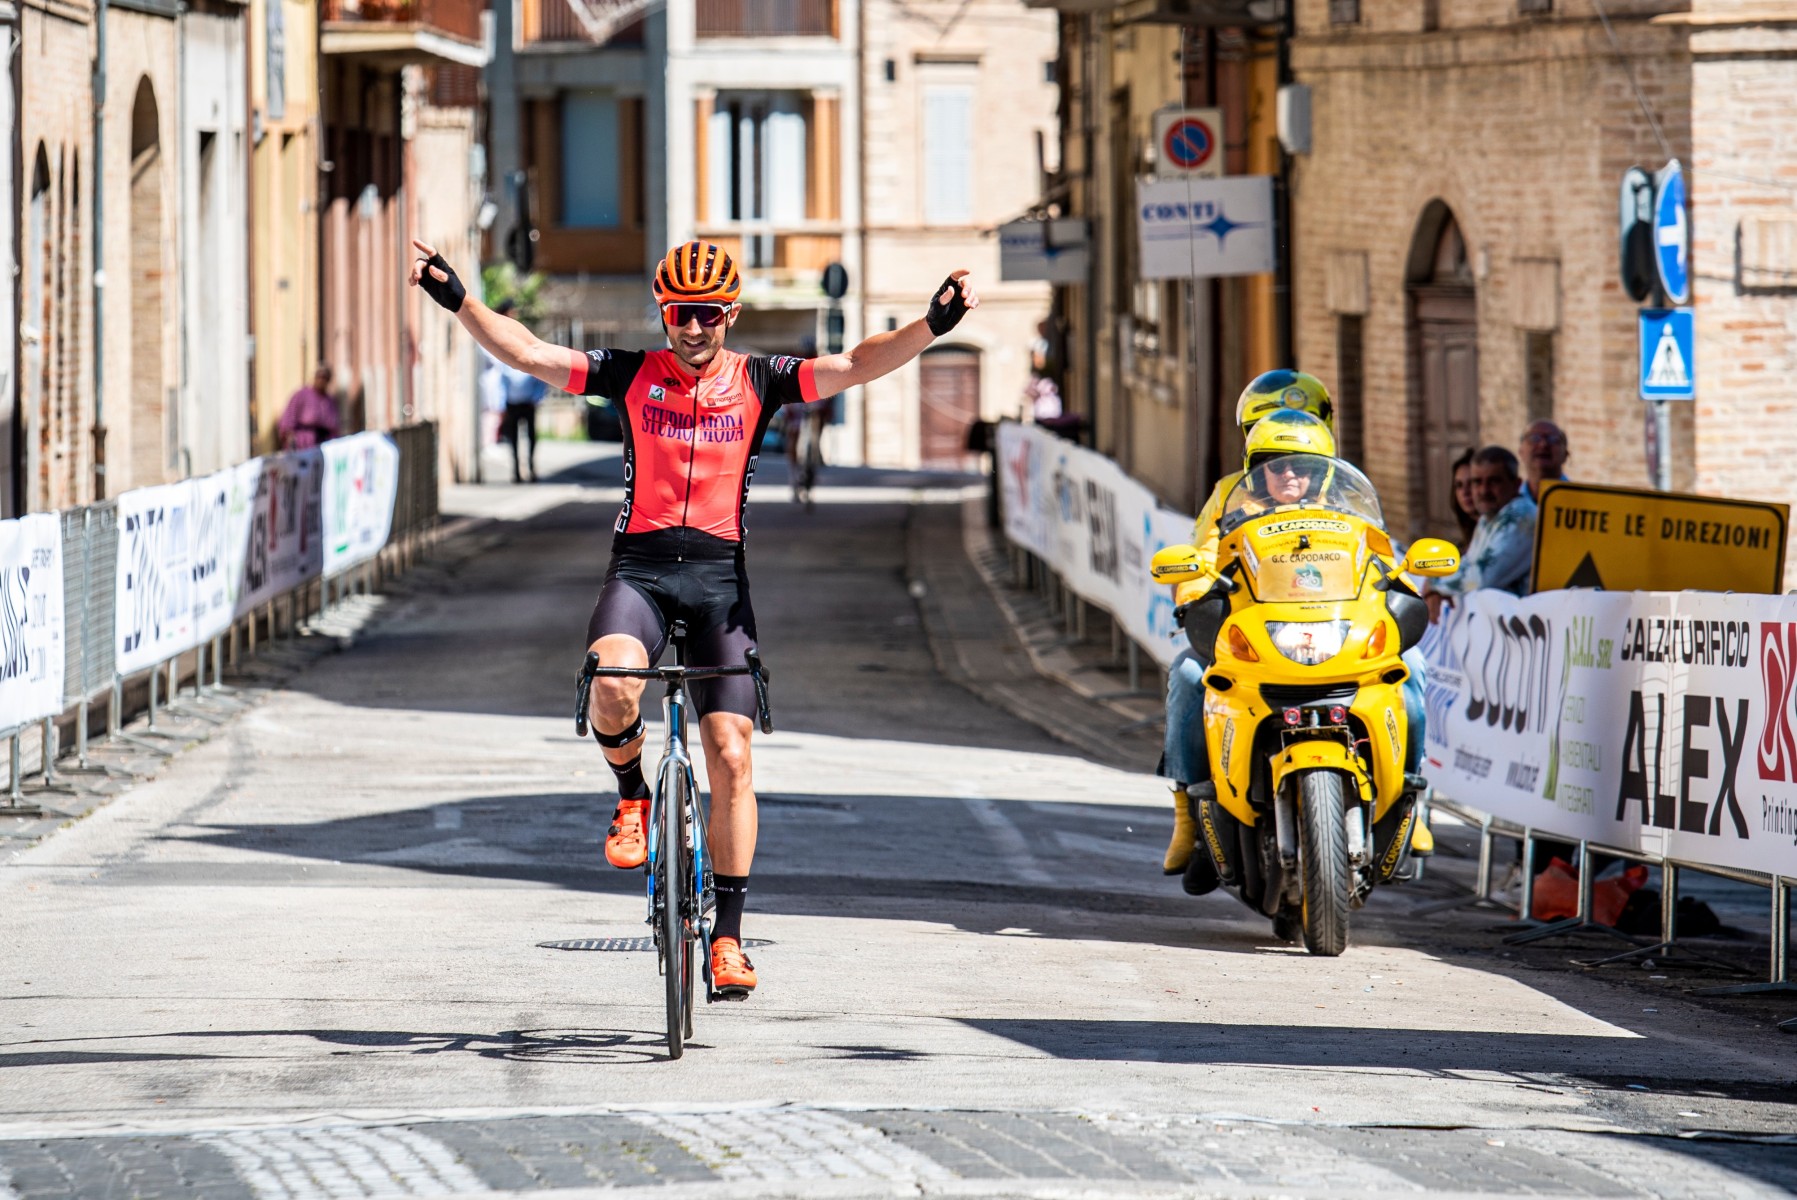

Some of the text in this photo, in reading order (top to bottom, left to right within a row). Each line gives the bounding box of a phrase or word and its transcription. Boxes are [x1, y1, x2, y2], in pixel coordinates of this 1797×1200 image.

[1142, 201, 1214, 222] CONTI
[642, 403, 694, 442] STUDIO
[699, 413, 744, 443] MODA
[1281, 521, 1348, 532] CAPODARCO
[1554, 507, 1770, 549] TUTTE LE DIREZIONI
[1271, 552, 1341, 563] G.C. CAPODARCO
[1620, 618, 1750, 668] CALZATURIFICIO
[1616, 690, 1750, 840] ALEX
[1201, 801, 1226, 862] G.C. CAPODARCO
[1386, 817, 1411, 864] CAPODARCO
